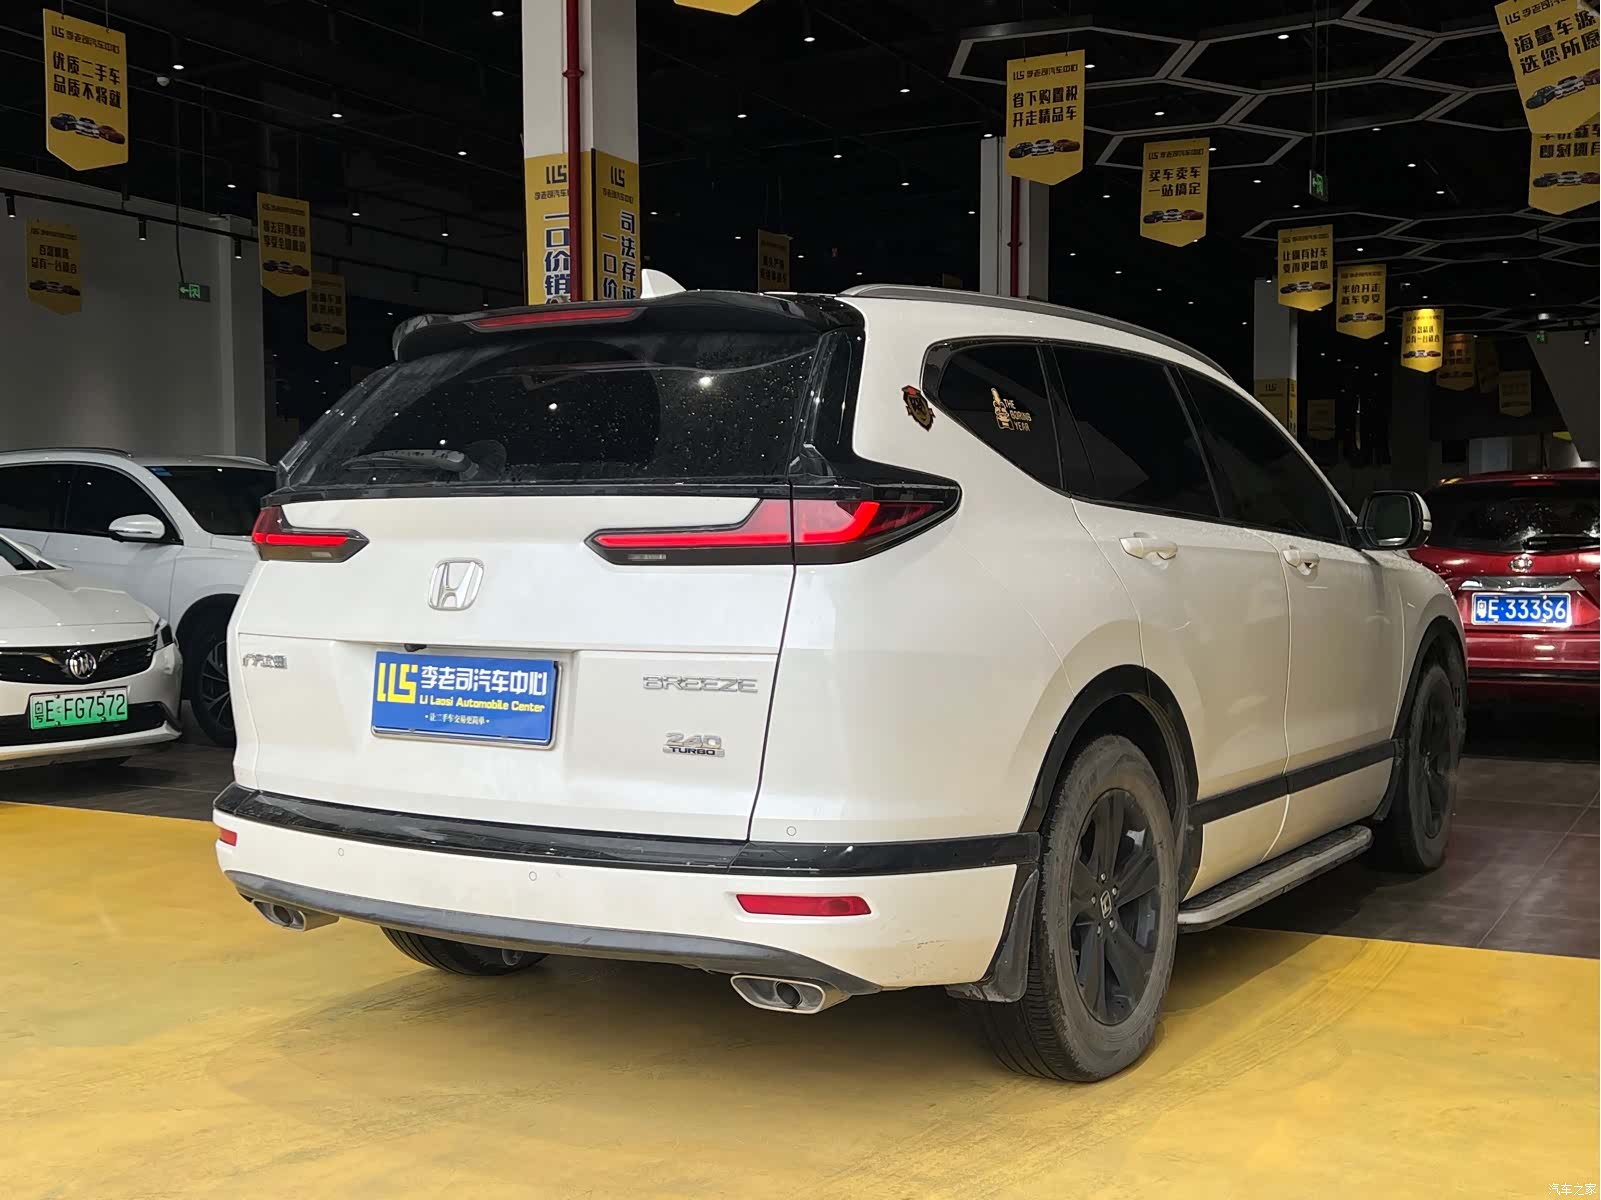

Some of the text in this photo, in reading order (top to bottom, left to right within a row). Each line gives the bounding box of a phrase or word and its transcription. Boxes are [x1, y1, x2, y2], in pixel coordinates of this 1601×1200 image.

[1513, 10, 1597, 54] 海量车源
[1519, 29, 1600, 75] 选您所愿
[53, 51, 120, 85] 优质二手车
[53, 74, 121, 109] 品质不将就
[1012, 85, 1077, 108] 省下购置税
[1013, 105, 1077, 128] 开走精品车
[1148, 166, 1202, 183] 买车卖车
[1148, 182, 1201, 197] 一站搞定
[543, 213, 571, 304] 一口价销
[1003, 398, 1016, 409] THE
[421, 665, 548, 696] 李老司汽车中心
[643, 676, 758, 693] BREEZE
[430, 695, 454, 707] Laosi
[455, 697, 509, 711] Automobile
[511, 701, 546, 712] Center
[664, 732, 722, 749] 240
[669, 746, 716, 756] TURBO
